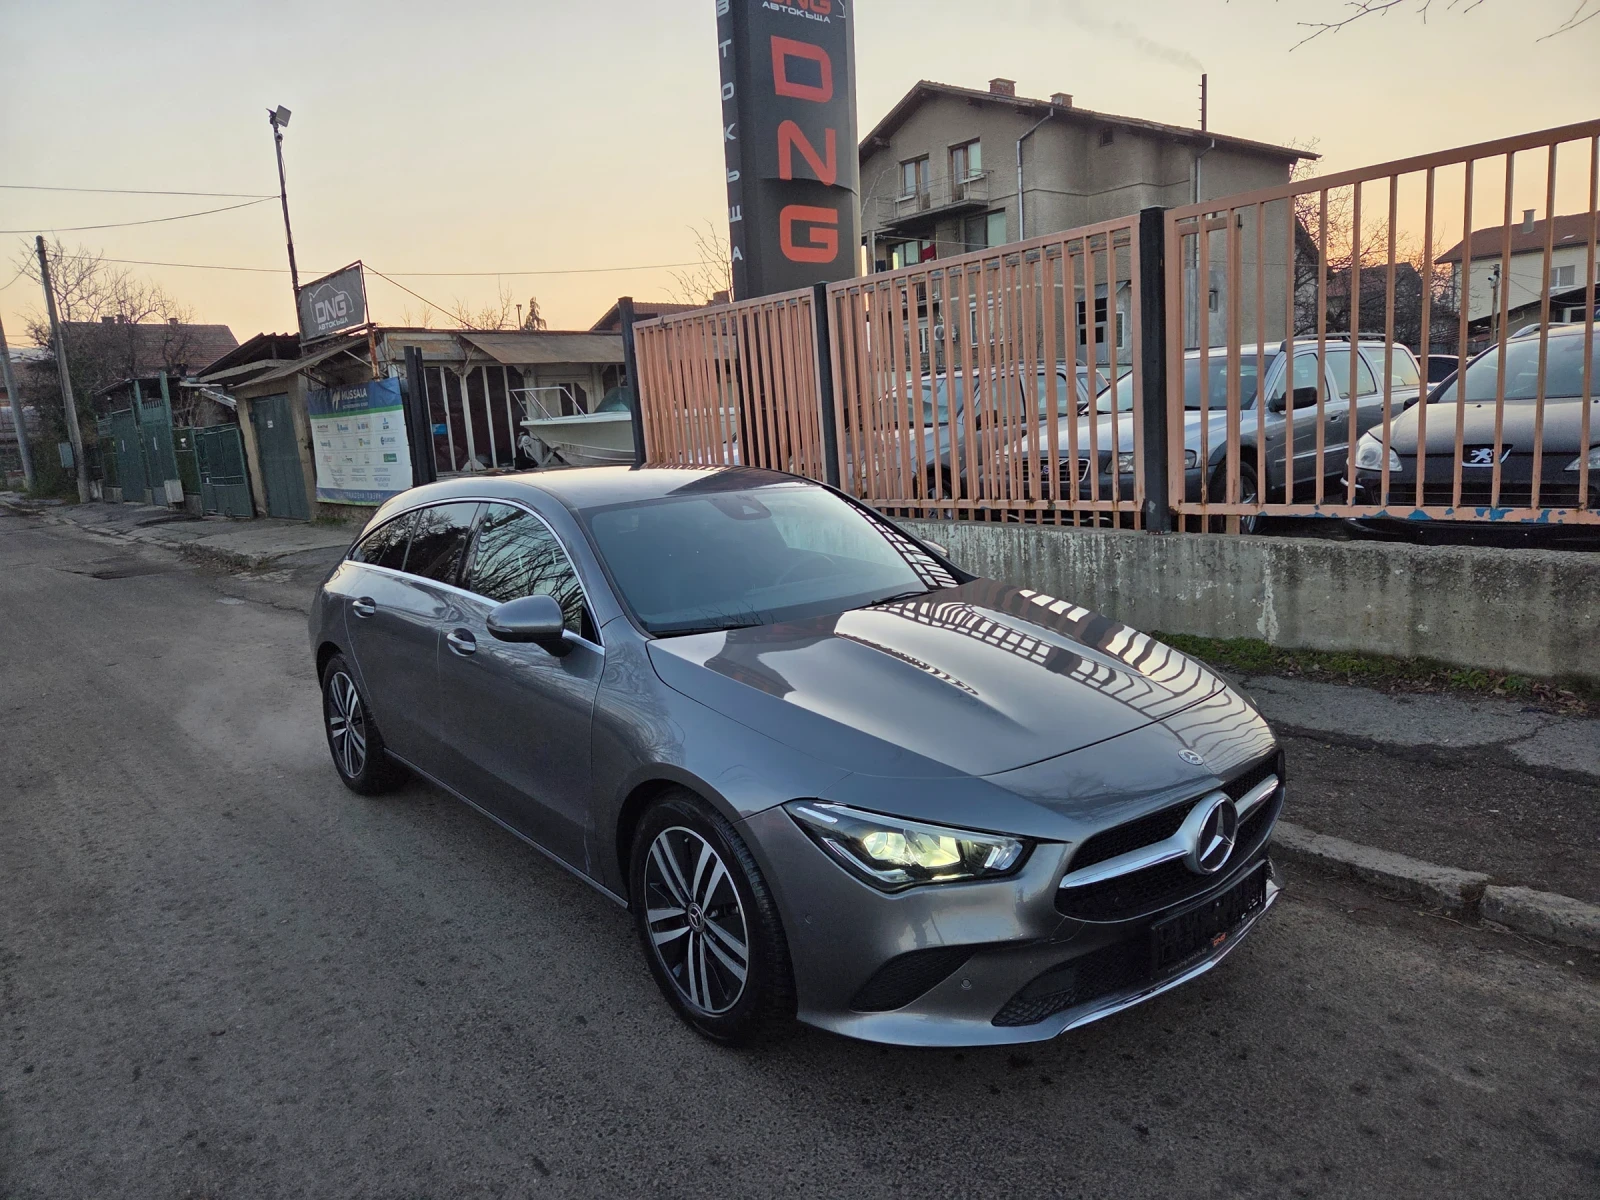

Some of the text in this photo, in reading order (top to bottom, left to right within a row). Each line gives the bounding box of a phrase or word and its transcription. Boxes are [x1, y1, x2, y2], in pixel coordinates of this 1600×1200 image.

[762, 1, 831, 23] АВТОКЪША
[770, 35, 838, 264] DNG
[315, 293, 347, 324] DNG
[318, 316, 349, 330] АВТОКЪША
[341, 387, 368, 400] MUSSALA
